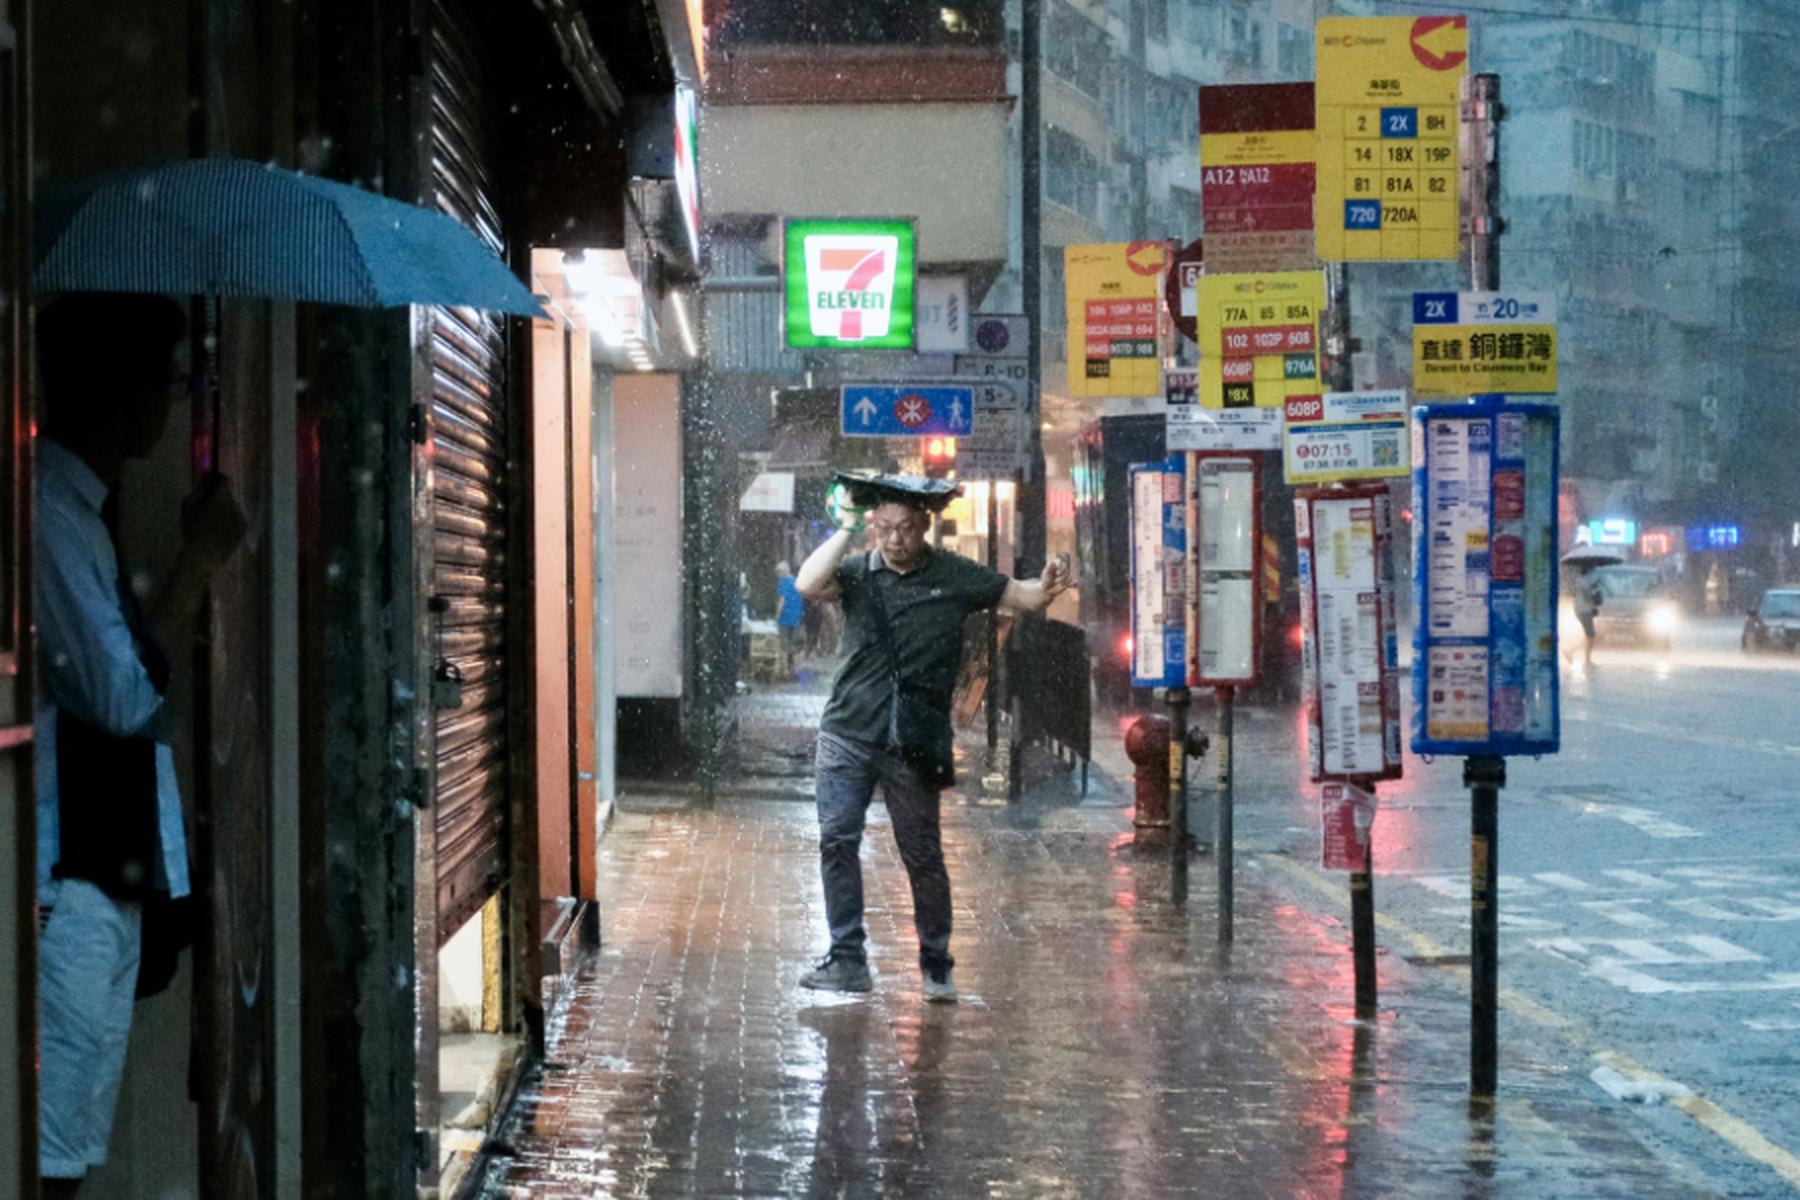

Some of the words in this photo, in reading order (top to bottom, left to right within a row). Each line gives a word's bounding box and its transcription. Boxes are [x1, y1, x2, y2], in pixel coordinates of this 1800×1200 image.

[1358, 116, 1367, 128] 2
[1389, 116, 1409, 131] 2X
[1426, 116, 1445, 130] 8H
[1355, 147, 1371, 161] 14
[1388, 147, 1413, 161] 18X
[1425, 147, 1450, 161] 19P
[1204, 168, 1234, 185] A12
[1354, 177, 1370, 192] 81
[1387, 177, 1413, 192] 81A
[1428, 177, 1446, 192] 82
[1351, 207, 1375, 222] 720
[1384, 207, 1418, 222] 720A
[820, 248, 885, 338] 7
[1225, 308, 1248, 321] 77A
[1261, 306, 1275, 320] 85
[1287, 305, 1310, 319] 85A
[1425, 300, 1446, 318] 2X
[1493, 298, 1519, 319] 20
[1227, 333, 1249, 348] 102
[1288, 331, 1311, 345] 608
[1421, 339, 1463, 361] 直達
[1470, 332, 1552, 361] 銅鑼灣
[1224, 361, 1253, 377] 608P
[1286, 360, 1315, 374] 976A
[1425, 363, 1458, 374] Direct
[1460, 363, 1471, 374] to
[1473, 363, 1526, 375] Causeway
[1527, 363, 1548, 375] Bay
[1288, 401, 1320, 417] 608P
[1311, 443, 1352, 458] 07:15
